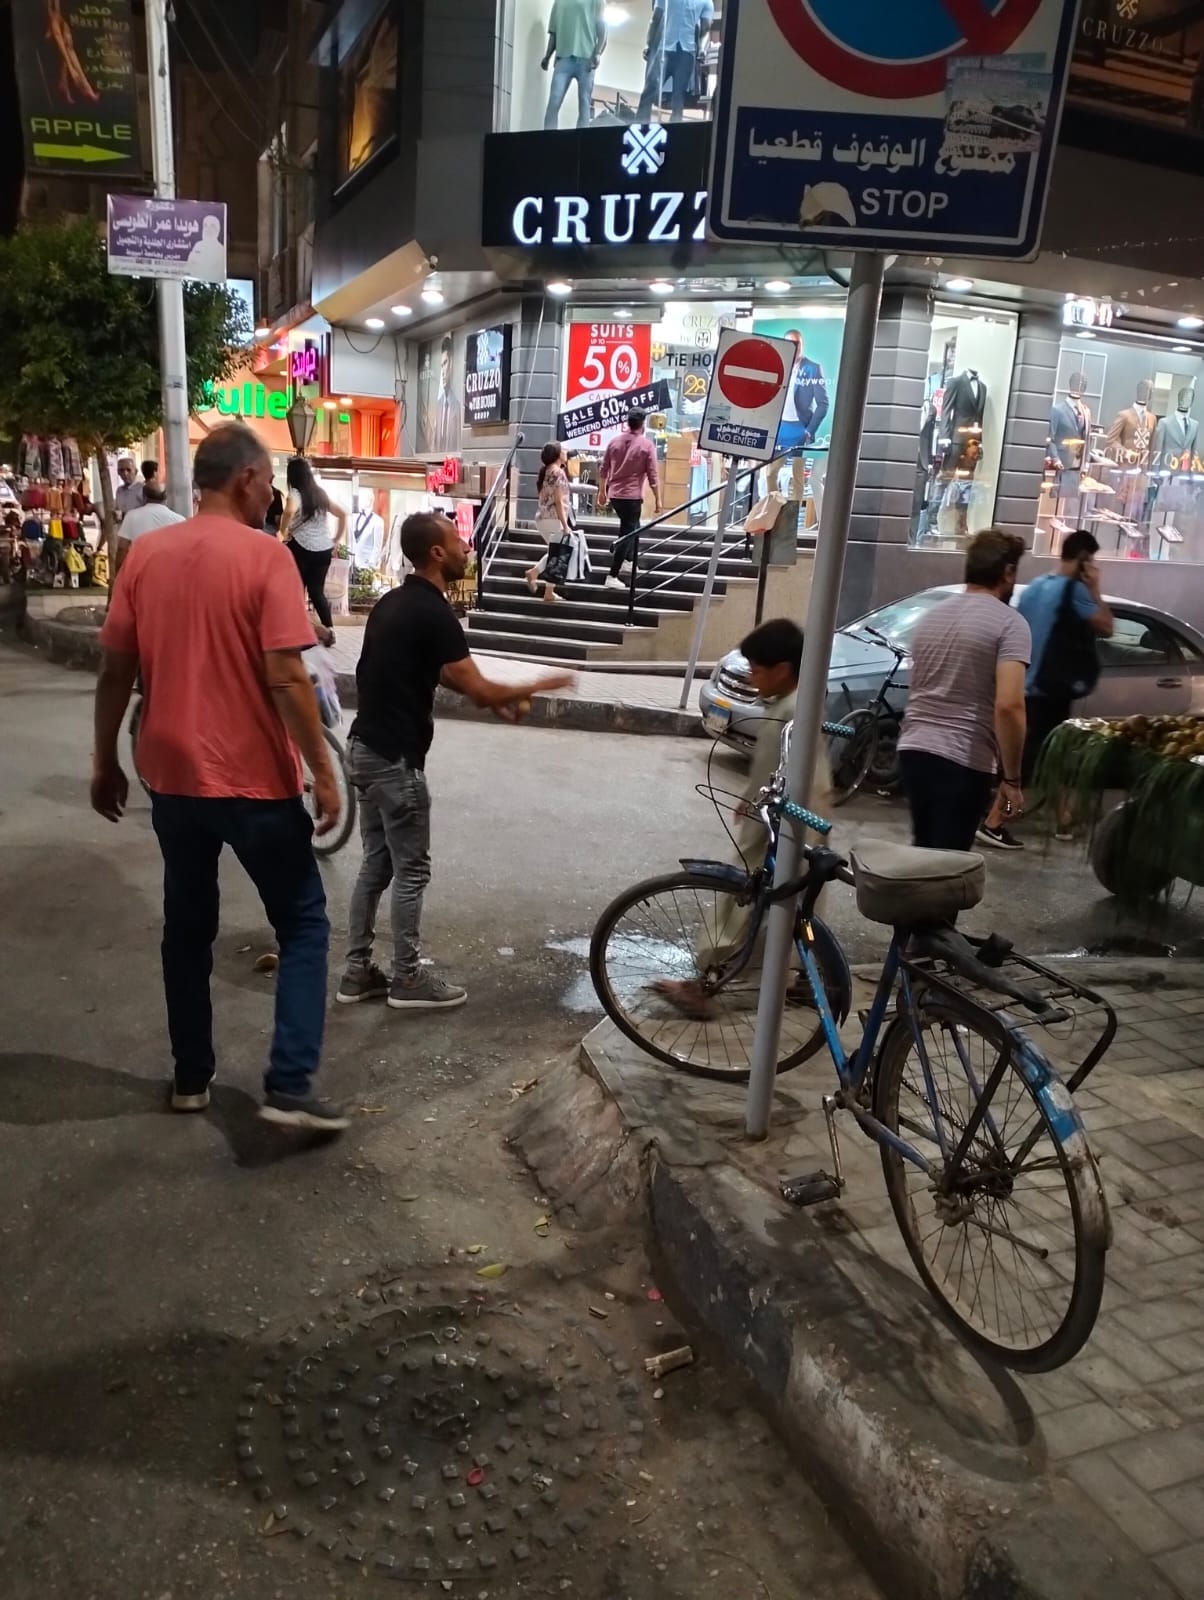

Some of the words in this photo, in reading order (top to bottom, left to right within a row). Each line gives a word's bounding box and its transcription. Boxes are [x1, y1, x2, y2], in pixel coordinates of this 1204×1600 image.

[1082, 17, 1163, 53] CRUZZO
[30, 117, 132, 140] APPLE
[748, 127, 823, 164] قطعيا
[832, 133, 927, 173] الوقوف
[860, 187, 949, 219] STOP
[591, 324, 634, 338] SUITS
[466, 368, 501, 393] CRUZZO
[563, 407, 594, 424] SALE
[600, 398, 629, 418] 60%
[631, 391, 655, 406] OFF
[566, 421, 601, 439] WEEKEND
[601, 415, 620, 427] ONLY
[717, 432, 731, 442] NO
[732, 434, 758, 446] ENTER
[1103, 446, 1173, 466] CRUZZO
